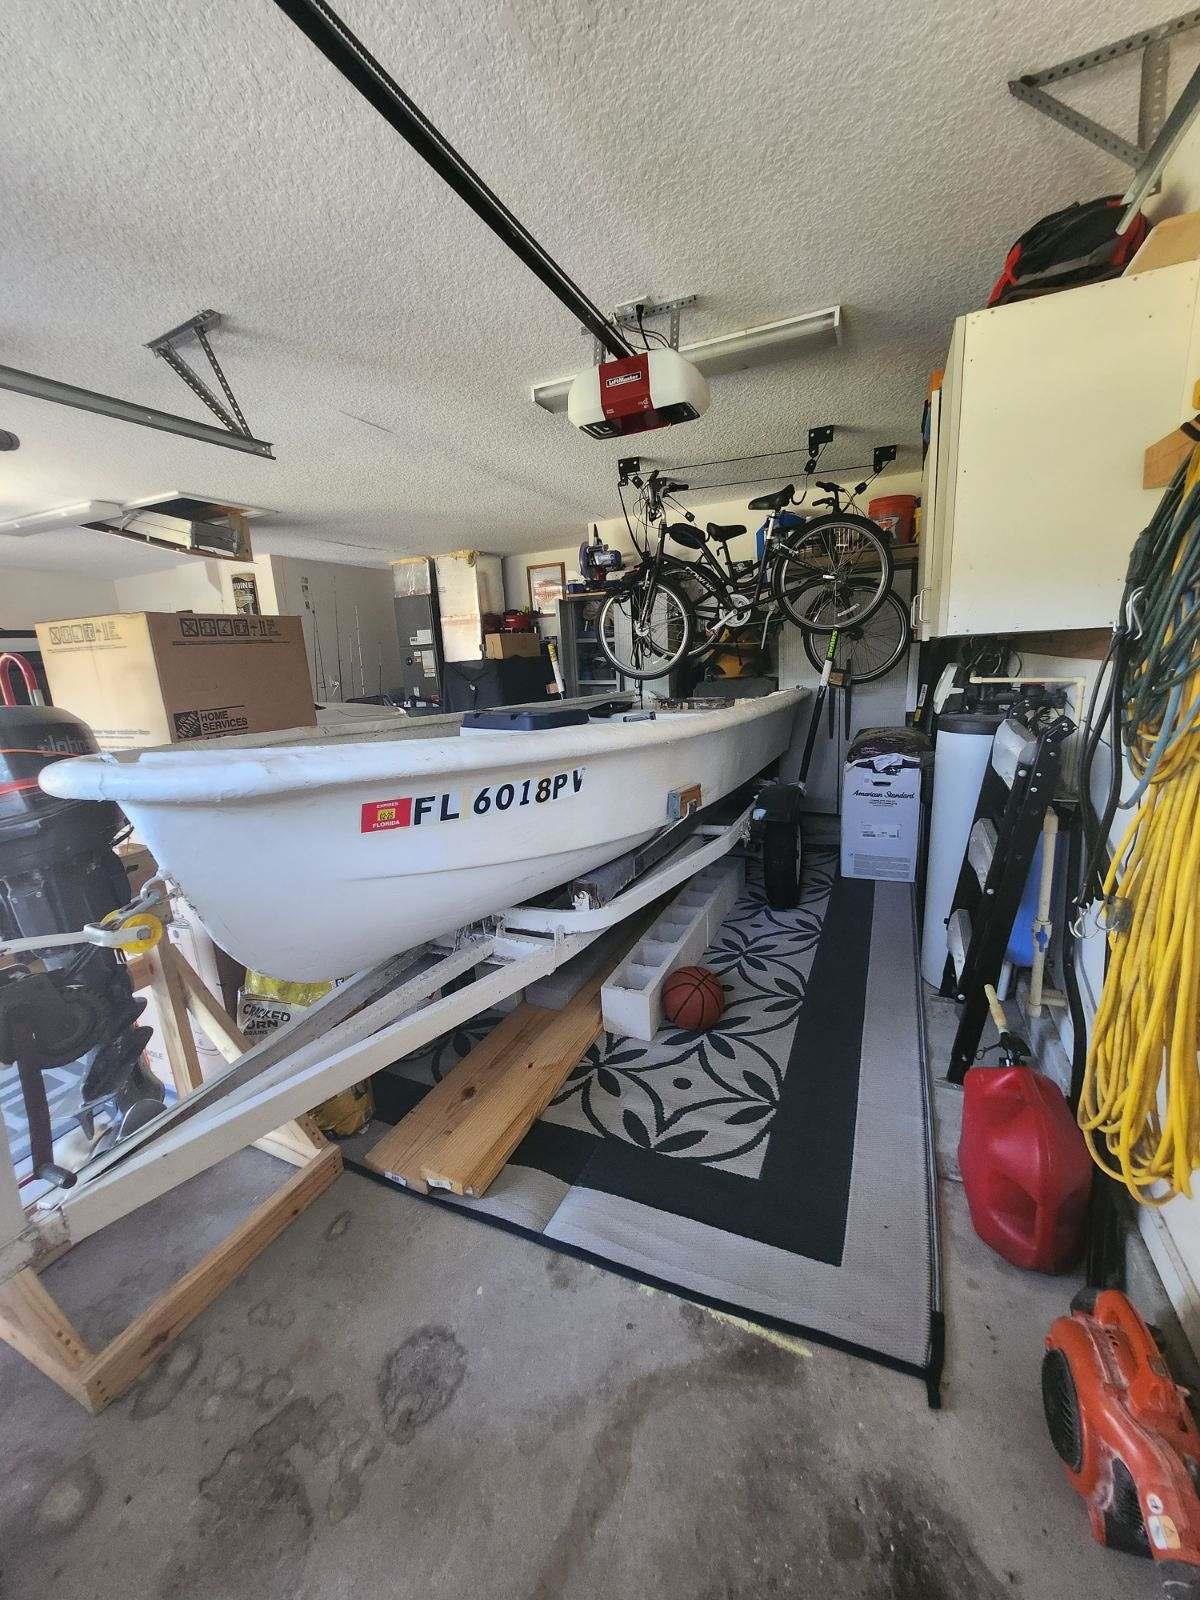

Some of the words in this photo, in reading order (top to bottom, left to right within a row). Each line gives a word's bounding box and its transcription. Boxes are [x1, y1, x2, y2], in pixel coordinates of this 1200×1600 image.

[201, 711, 229, 722] HOME
[202, 718, 248, 732] SERVICES
[852, 789, 883, 798] American
[885, 790, 915, 799] Standard
[413, 795, 460, 826] FL
[372, 819, 400, 829] FLORIDA
